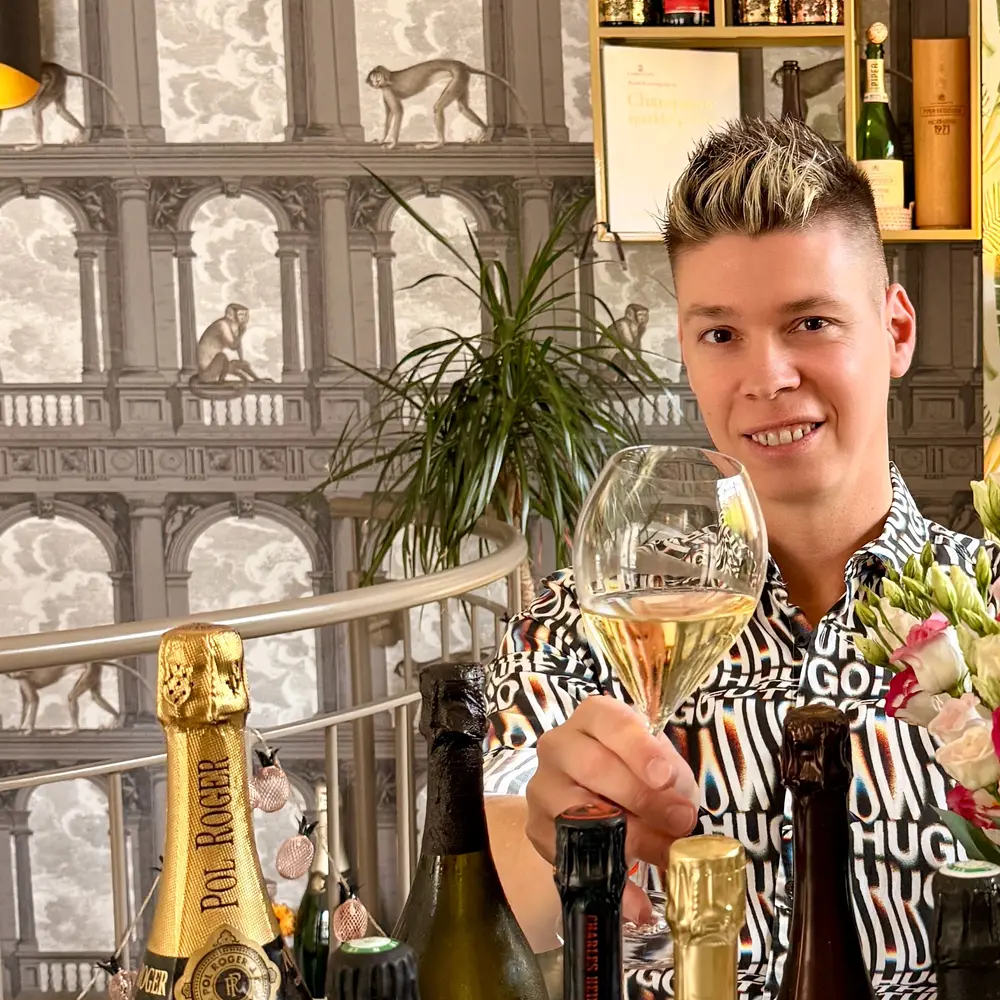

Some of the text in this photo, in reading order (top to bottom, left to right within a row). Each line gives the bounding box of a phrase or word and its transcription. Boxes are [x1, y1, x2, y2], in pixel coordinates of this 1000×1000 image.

[195, 756, 239, 913] POL ROGER
[850, 817, 961, 870] HUG
[137, 964, 169, 997] OGER
[202, 974, 213, 995] POL
[212, 954, 249, 972] ROGER
